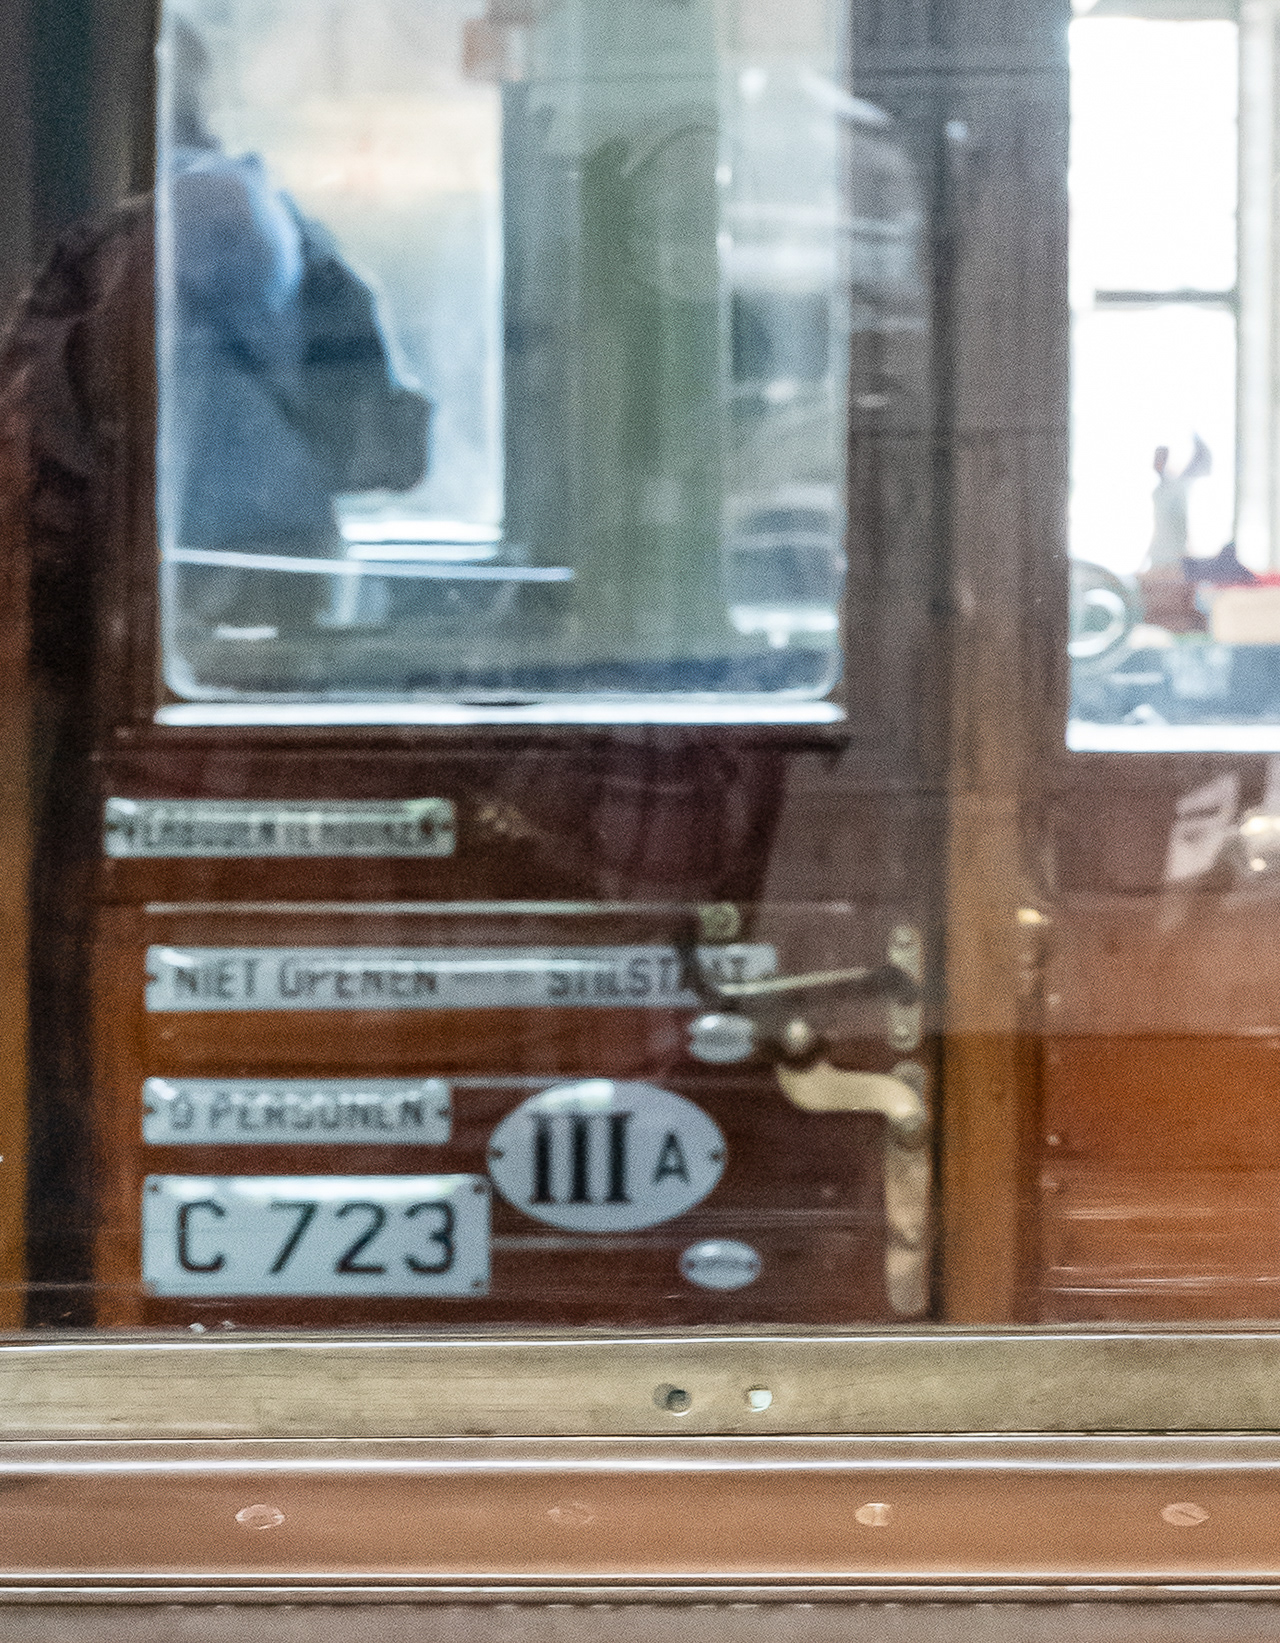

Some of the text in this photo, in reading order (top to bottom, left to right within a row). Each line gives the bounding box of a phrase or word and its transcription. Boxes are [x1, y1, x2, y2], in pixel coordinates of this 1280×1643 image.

[528, 1110, 692, 1206] III A
[177, 1200, 456, 1275] C 723
